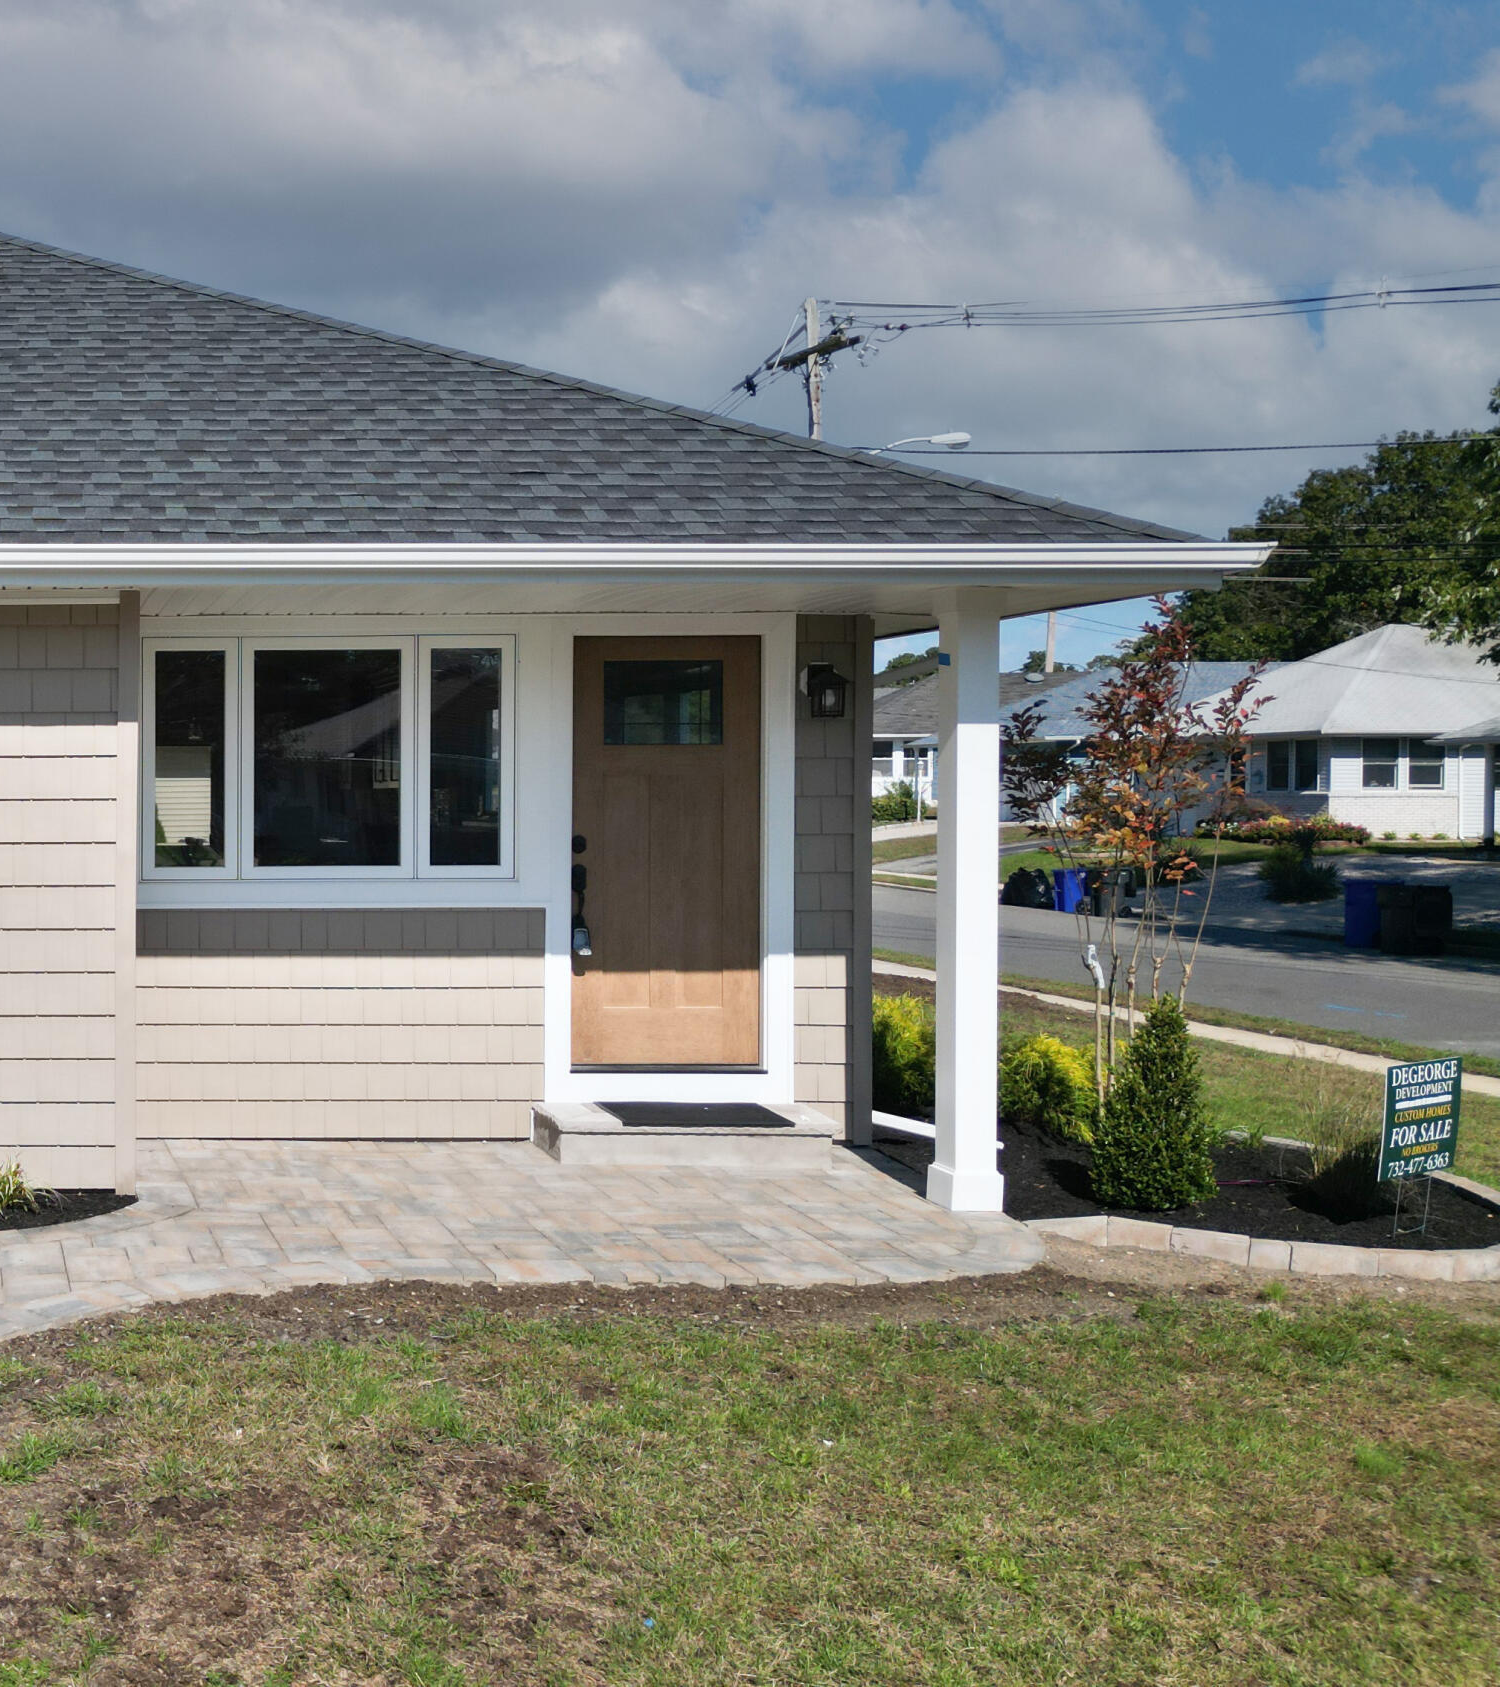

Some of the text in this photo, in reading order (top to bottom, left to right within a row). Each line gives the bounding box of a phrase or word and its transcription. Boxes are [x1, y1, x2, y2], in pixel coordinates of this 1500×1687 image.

[1392, 1060, 1458, 1087] DEGEORGE
[1395, 1081, 1453, 1100] DEVELOPMENT
[1395, 1104, 1451, 1123] CUSTOM HOMES
[1390, 1119, 1452, 1148] FOR SALE
[1388, 1152, 1449, 1178] 732-477-6363
